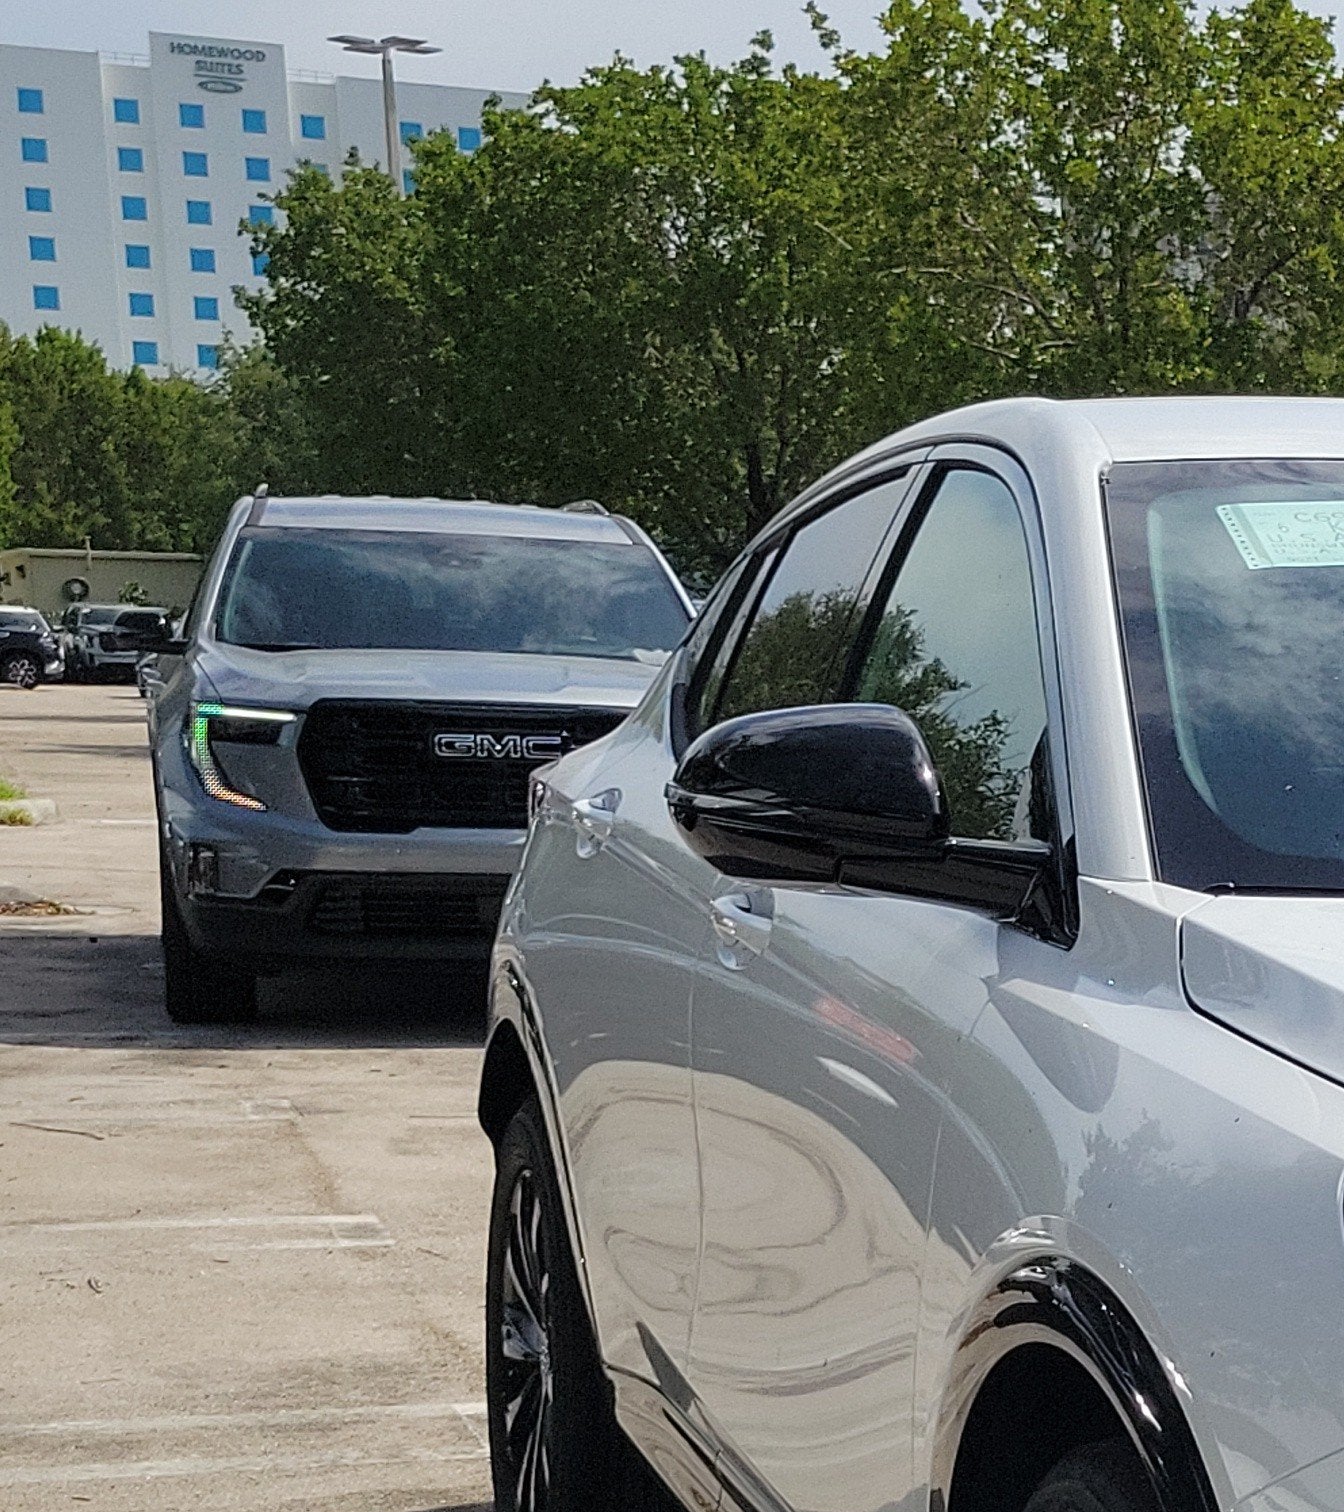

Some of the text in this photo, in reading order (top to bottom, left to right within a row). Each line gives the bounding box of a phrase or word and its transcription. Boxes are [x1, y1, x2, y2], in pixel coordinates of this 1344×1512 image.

[169, 41, 266, 62] HOMEWOOD
[195, 59, 244, 75] SUITES
[434, 733, 561, 760] GMC
